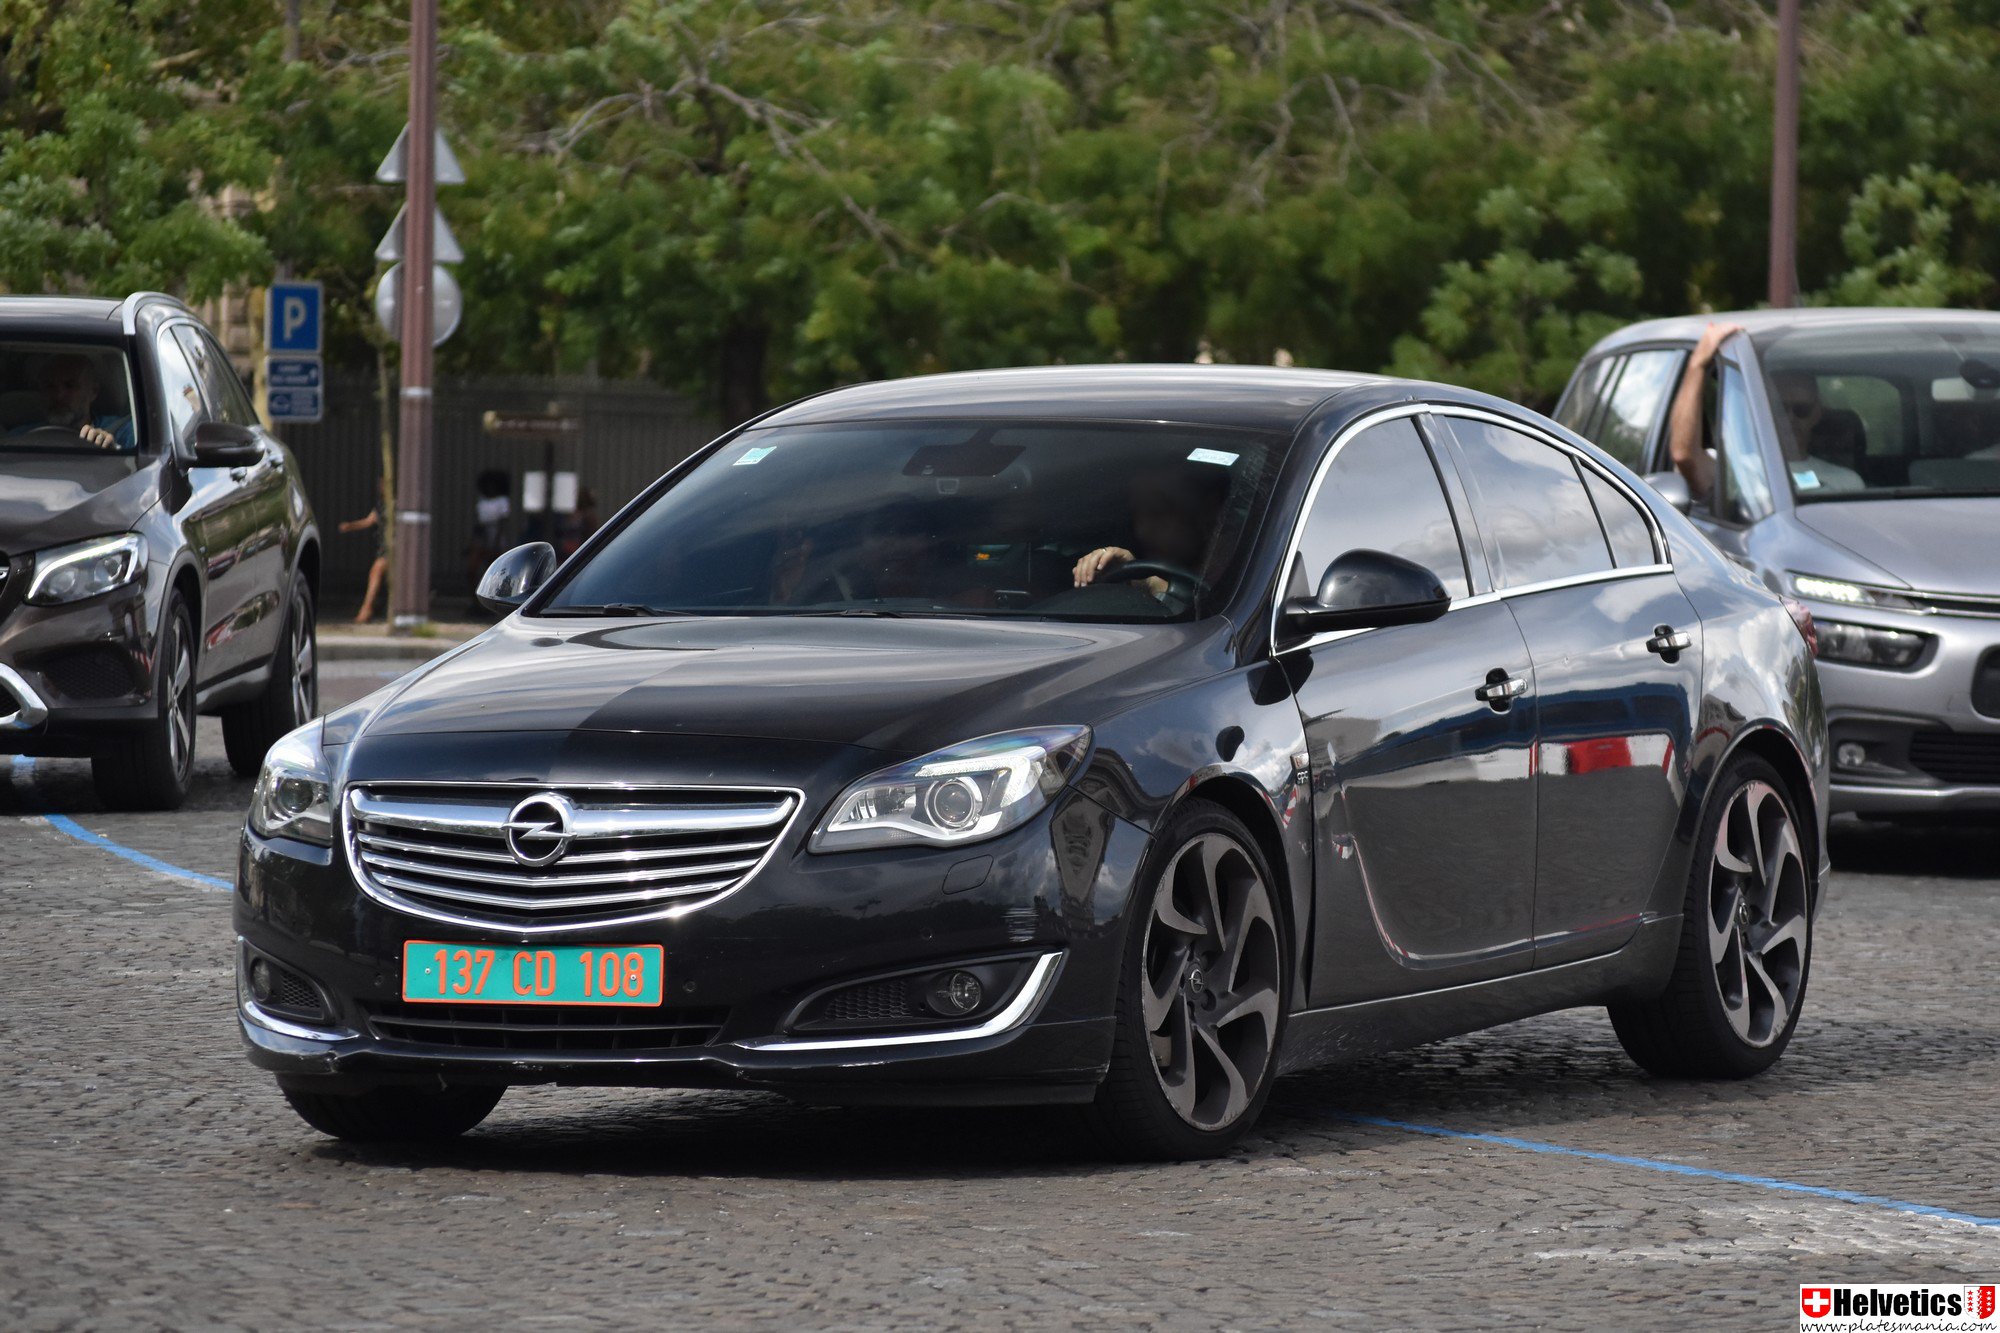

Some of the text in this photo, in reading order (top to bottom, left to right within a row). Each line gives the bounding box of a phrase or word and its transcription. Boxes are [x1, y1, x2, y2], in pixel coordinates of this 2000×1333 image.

[283, 297, 306, 341] P
[434, 949, 645, 998] 137 CD 108
